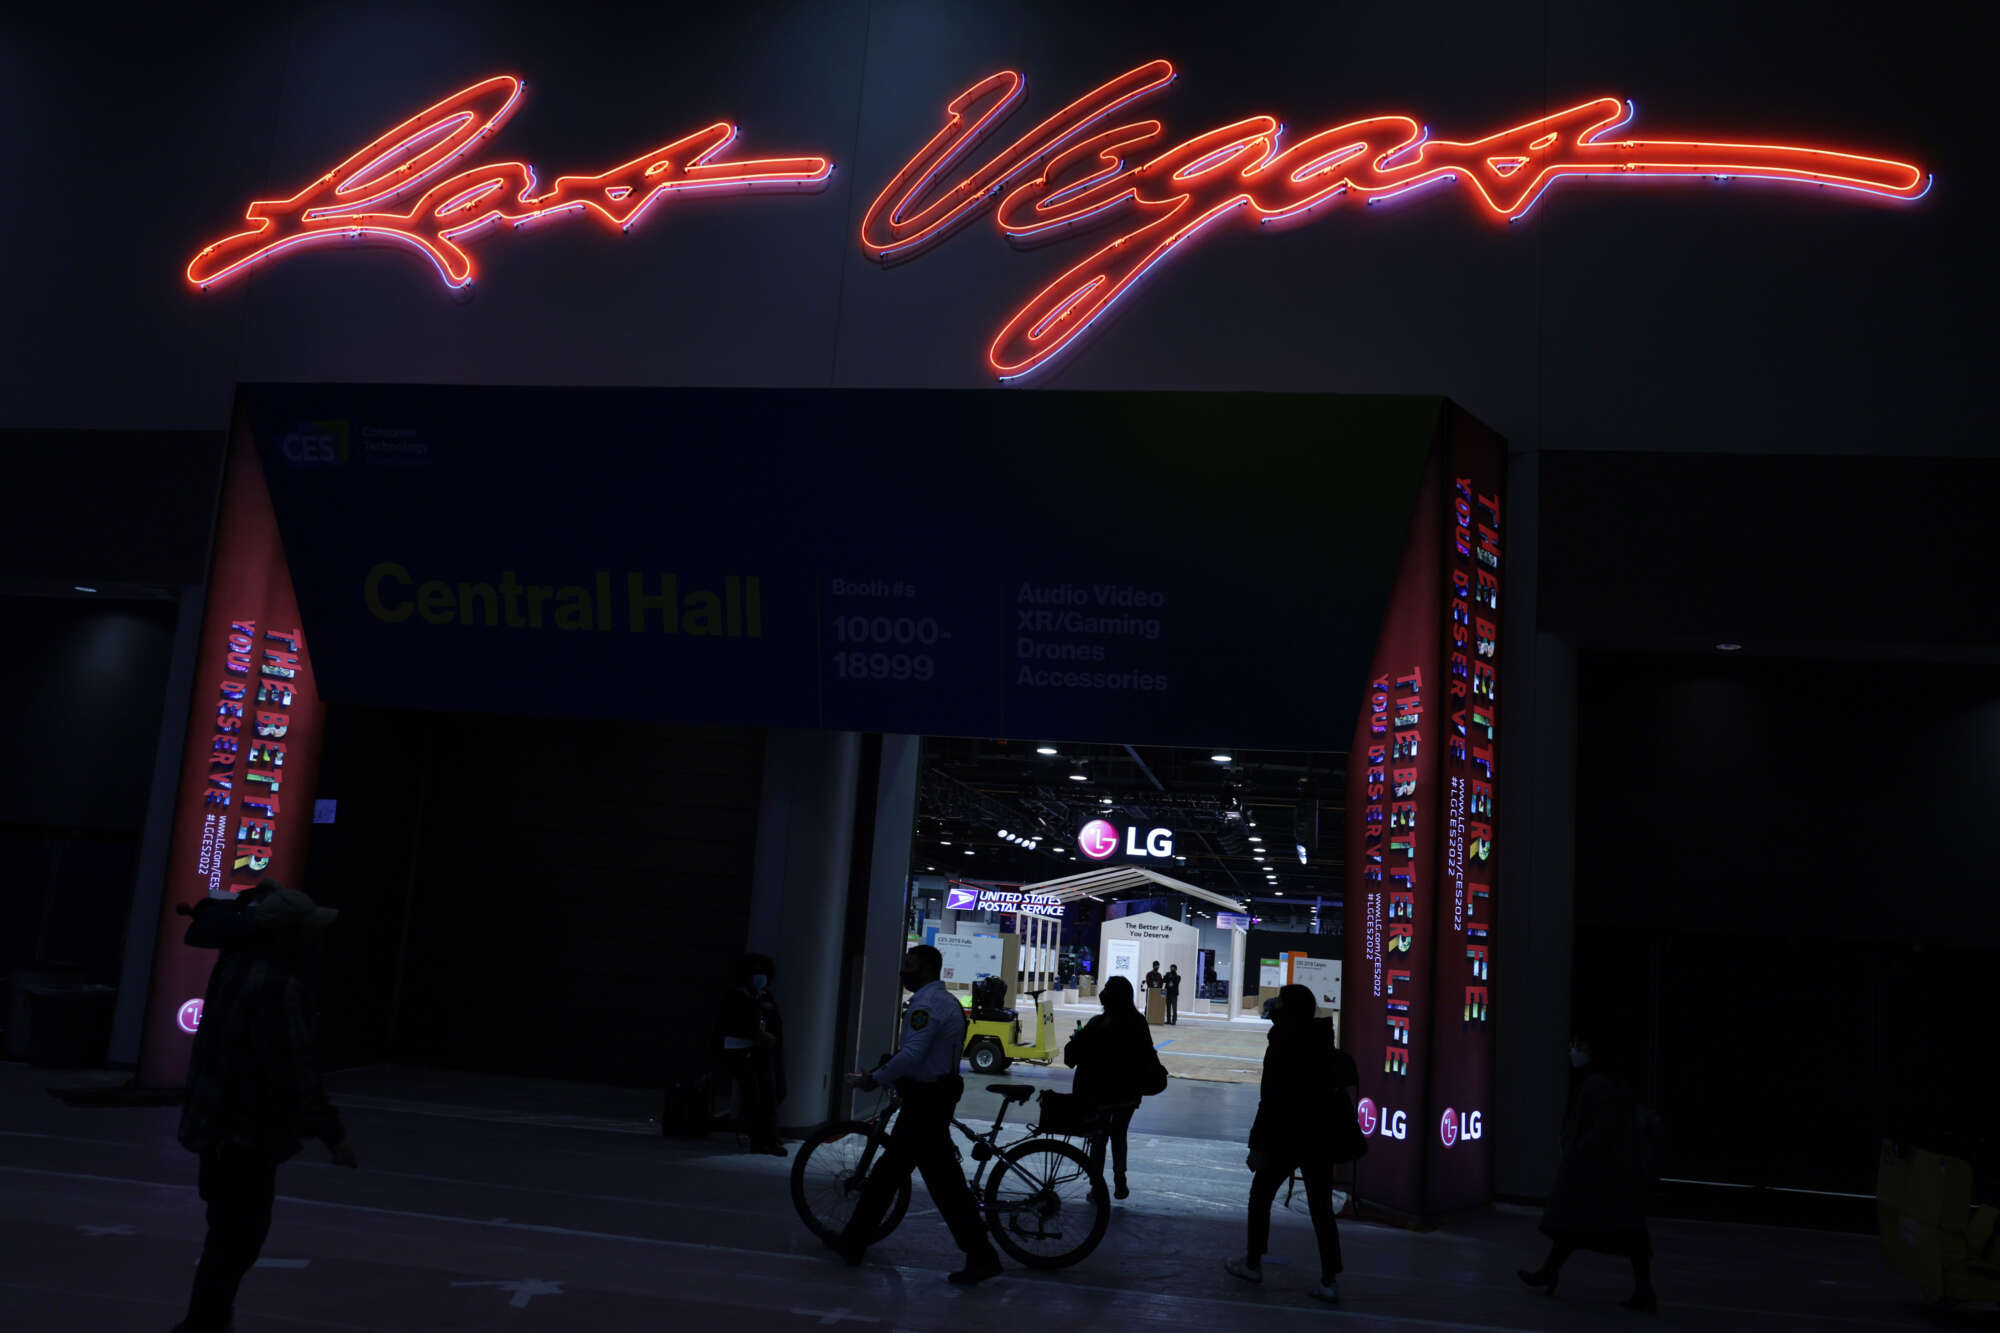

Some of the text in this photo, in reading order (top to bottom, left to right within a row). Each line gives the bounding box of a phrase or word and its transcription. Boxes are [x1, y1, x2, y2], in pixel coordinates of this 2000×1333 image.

[187, 59, 1932, 381] Las Vegas
[363, 561, 763, 639] Central Hall
[831, 577, 887, 598] Booth
[1016, 583, 1166, 608] Audio Video
[832, 615, 952, 645] 10000-
[1016, 609, 1161, 639] XR/Gaming
[1449, 477, 1472, 761] YOU DESERVE
[832, 651, 936, 681] 18999
[1016, 638, 1105, 662] Drones
[256, 628, 302, 706] THE
[1016, 665, 1168, 691] Accessories
[203, 620, 256, 807] YOU DESERVE
[1464, 494, 1499, 1022] THE BETTER LIFE
[233, 710, 289, 871] BETTER
[1364, 673, 1389, 881] YOU DESERVE
[1126, 826, 1173, 858] LG
[1448, 776, 1458, 877] #LGCES2022
[198, 814, 216, 875] #LGCES2022
[209, 815, 227, 890] www.LG.com/CES
[1385, 666, 1423, 1076] THE BETTER LIFE
[977, 901, 1065, 917] POSTAL SERVICE
[979, 891, 1062, 906] UNITED STATES
[1129, 930, 1169, 939] You Deserve
[1138, 923, 1159, 931] Better
[1160, 924, 1173, 932] Life
[1381, 1107, 1407, 1140] LG
[1461, 1110, 1481, 1141] LG
